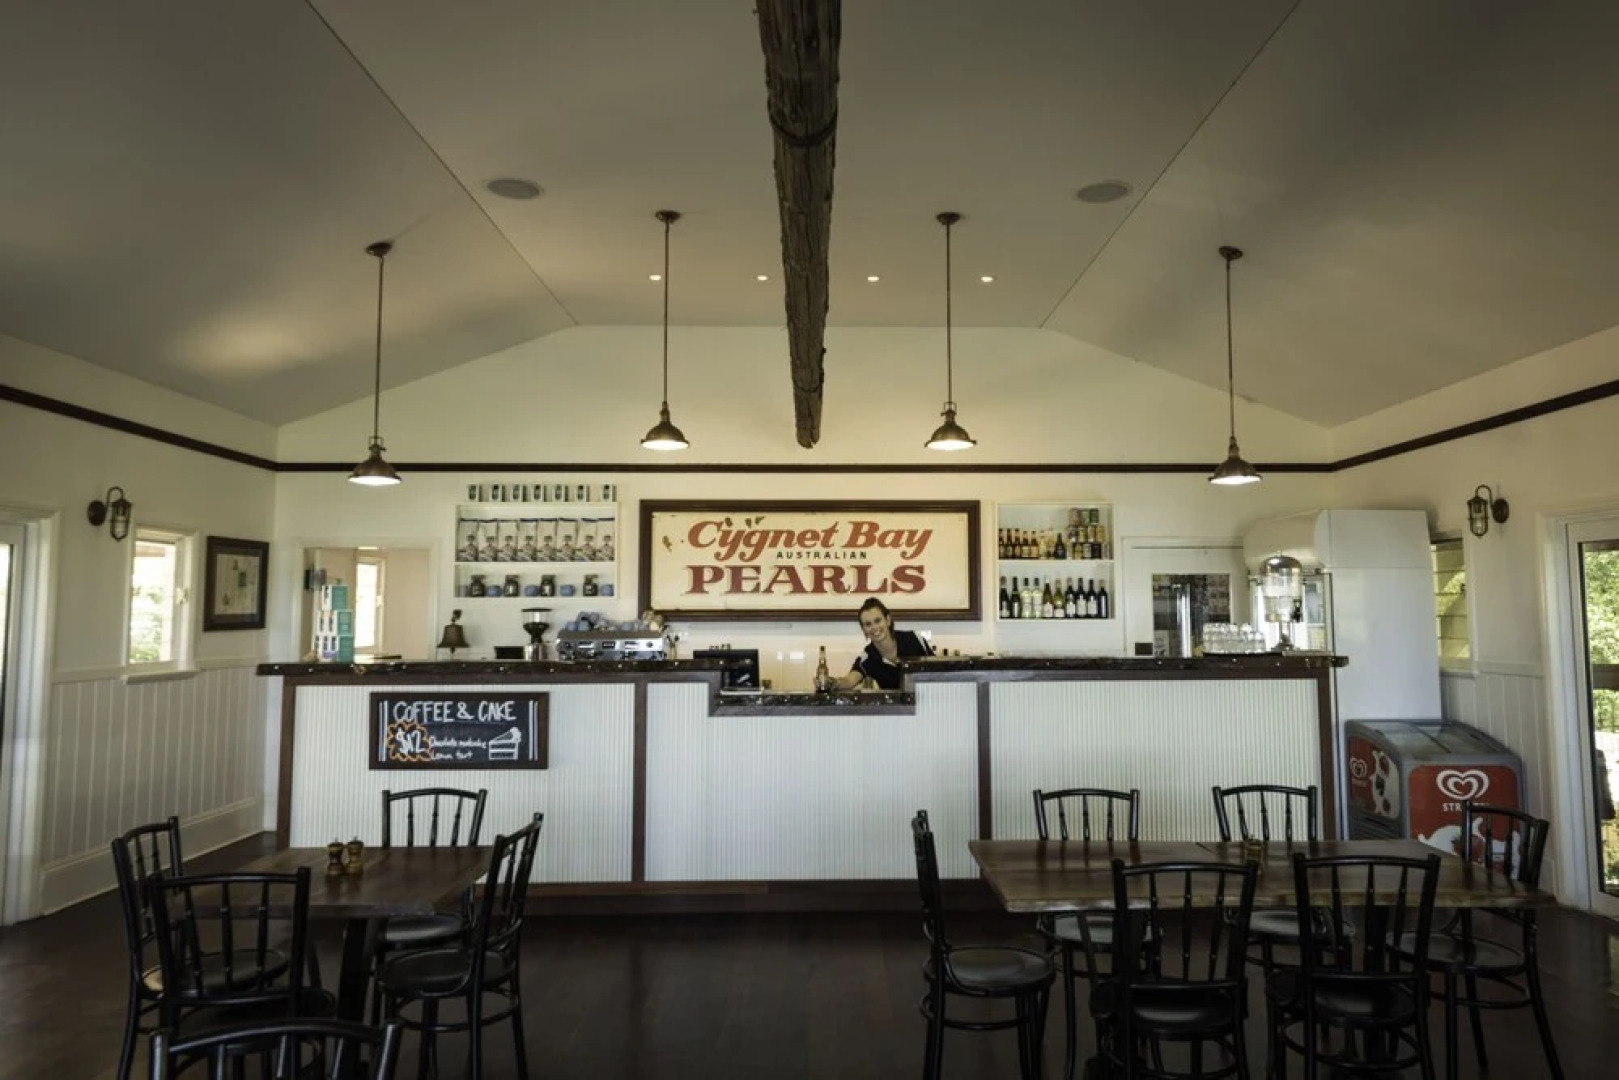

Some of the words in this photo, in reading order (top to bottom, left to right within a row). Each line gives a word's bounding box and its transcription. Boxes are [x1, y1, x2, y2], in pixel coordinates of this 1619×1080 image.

[687, 519, 840, 562] Cygnet
[842, 520, 933, 560] Bay
[776, 551, 867, 560] AUSTRALIAN
[684, 565, 927, 595] PEARLS
[393, 701, 455, 724] COFFEE
[457, 701, 475, 720] &
[478, 701, 517, 722] CAKE
